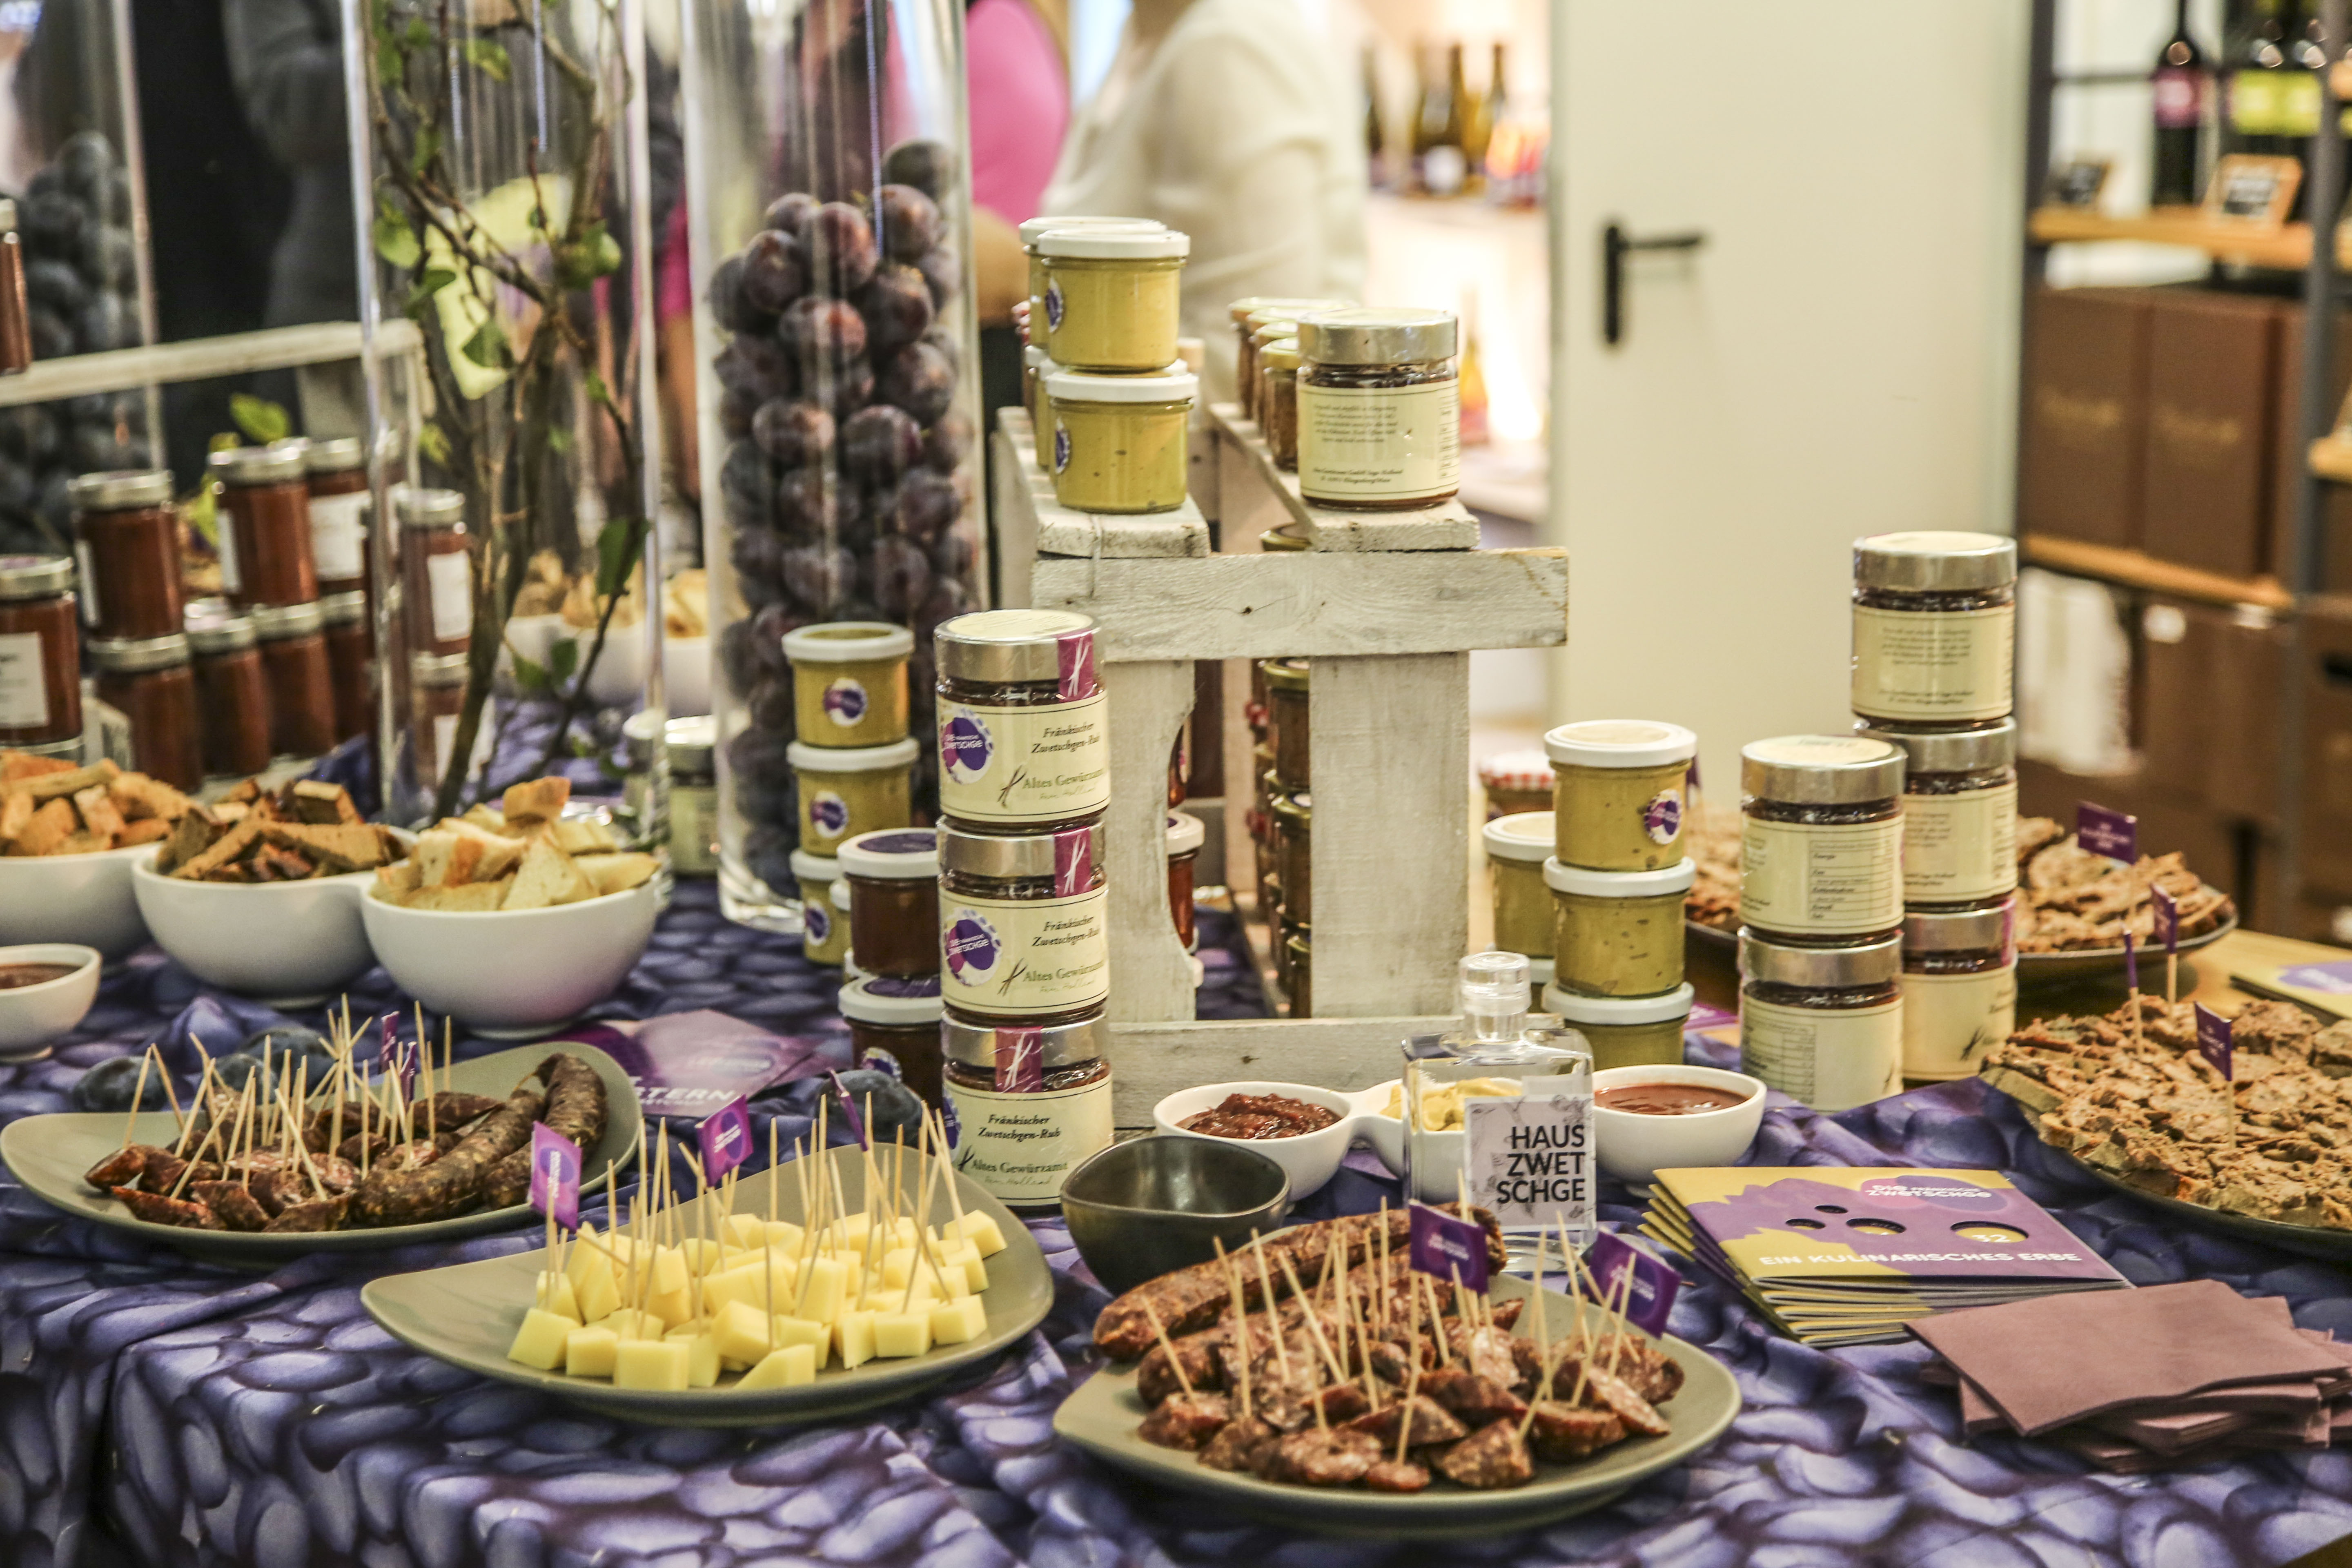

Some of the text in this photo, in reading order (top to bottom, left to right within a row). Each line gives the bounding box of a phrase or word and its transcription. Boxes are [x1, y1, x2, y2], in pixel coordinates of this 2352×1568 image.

[988, 1114, 1050, 1125] Fränkischer
[978, 1127, 1061, 1143] Zwetschgen-Rub
[1512, 1125, 1585, 1149] HAUS
[1507, 1152, 1585, 1176] ZWET
[1497, 1178, 1585, 1204] SCHGE
[1760, 1256, 1801, 1265] EIN
[1809, 1253, 2013, 1263] KULINARISCHES
